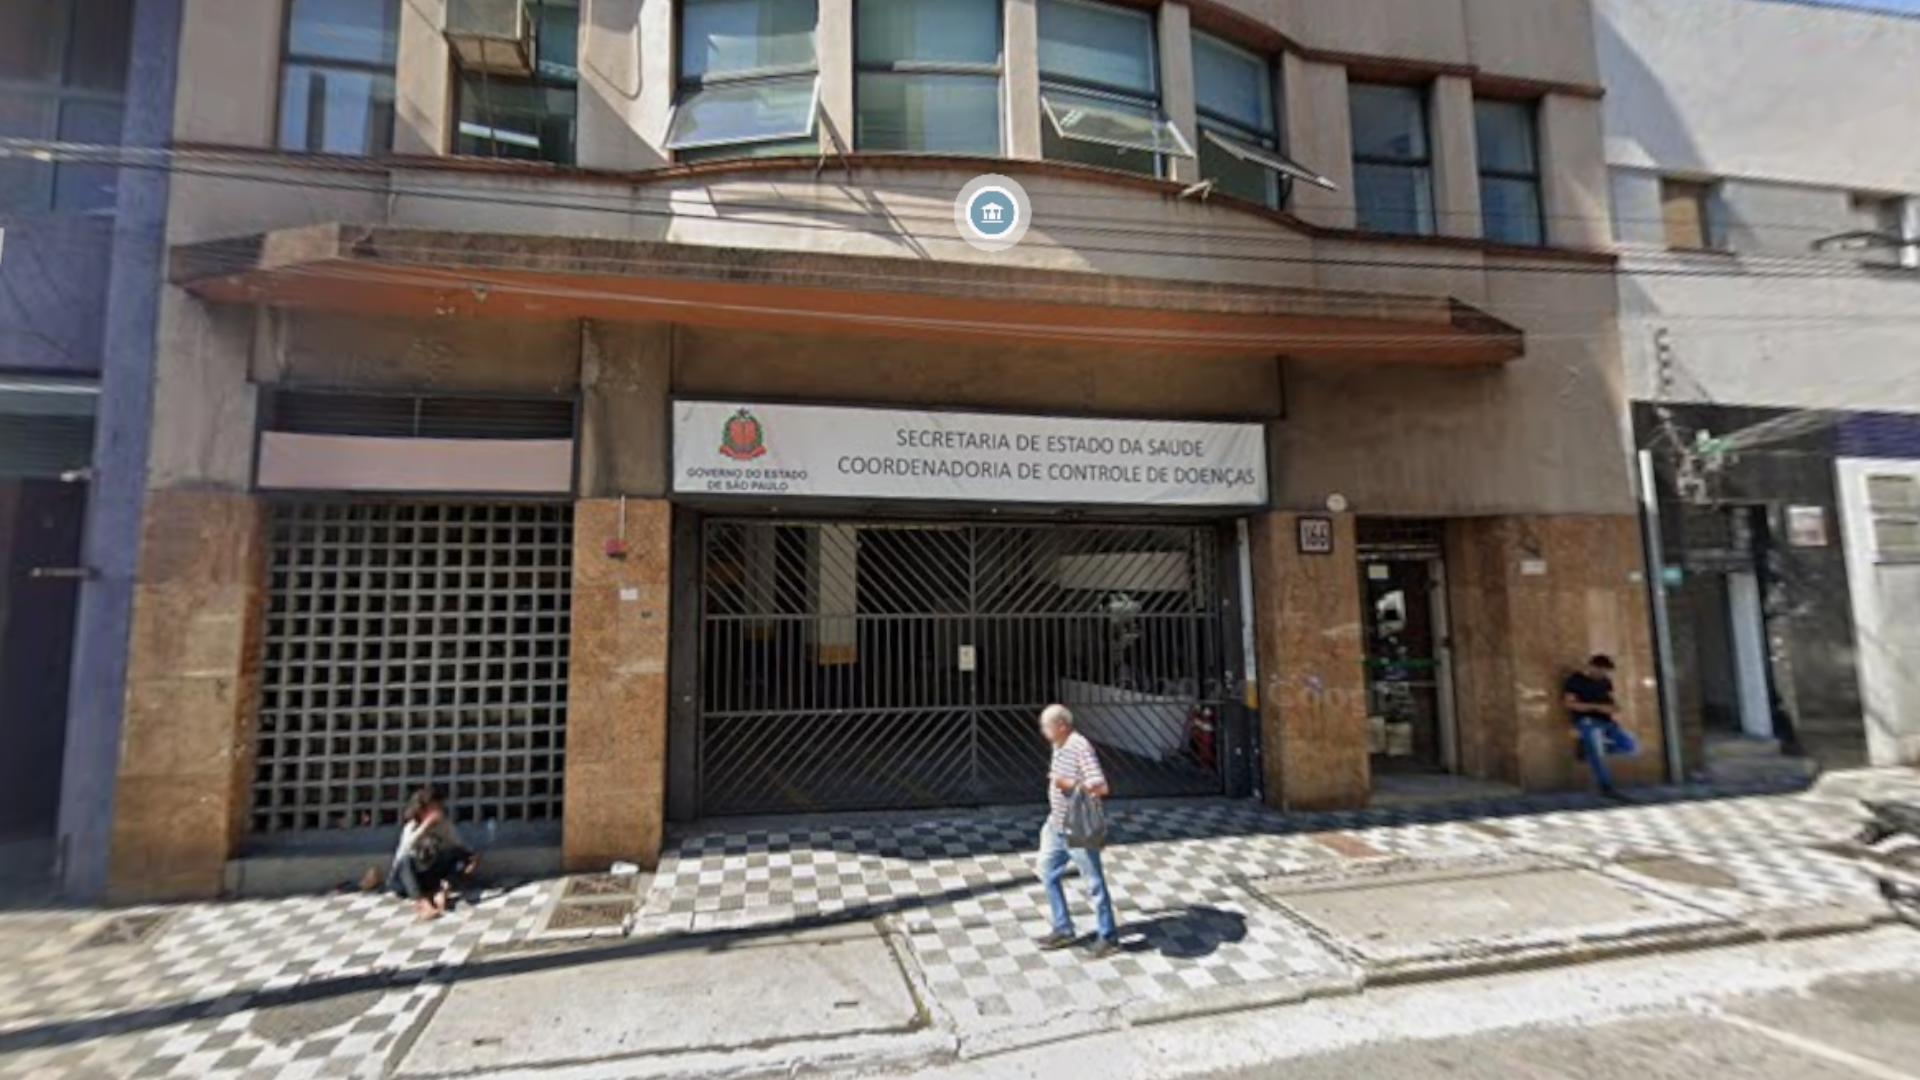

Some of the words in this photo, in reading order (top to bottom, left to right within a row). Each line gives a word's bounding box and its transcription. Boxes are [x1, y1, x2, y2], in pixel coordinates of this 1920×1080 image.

[896, 428, 1011, 450] SECRETARIA
[1016, 434, 1041, 451] DE
[1047, 436, 1114, 454] ESTADO
[1120, 438, 1143, 455] DA
[686, 467, 743, 479] GOVERNO
[746, 469, 761, 480] DO
[764, 469, 808, 481] ESTADO
[838, 455, 1012, 479] COORDENADORIA
[1018, 462, 1042, 480] DE
[1048, 463, 1141, 483] CONTROLE
[1146, 466, 1169, 483] DE
[1174, 467, 1255, 488] DOENÇAS
[707, 480, 722, 491] DE
[751, 481, 789, 492] PAULO
